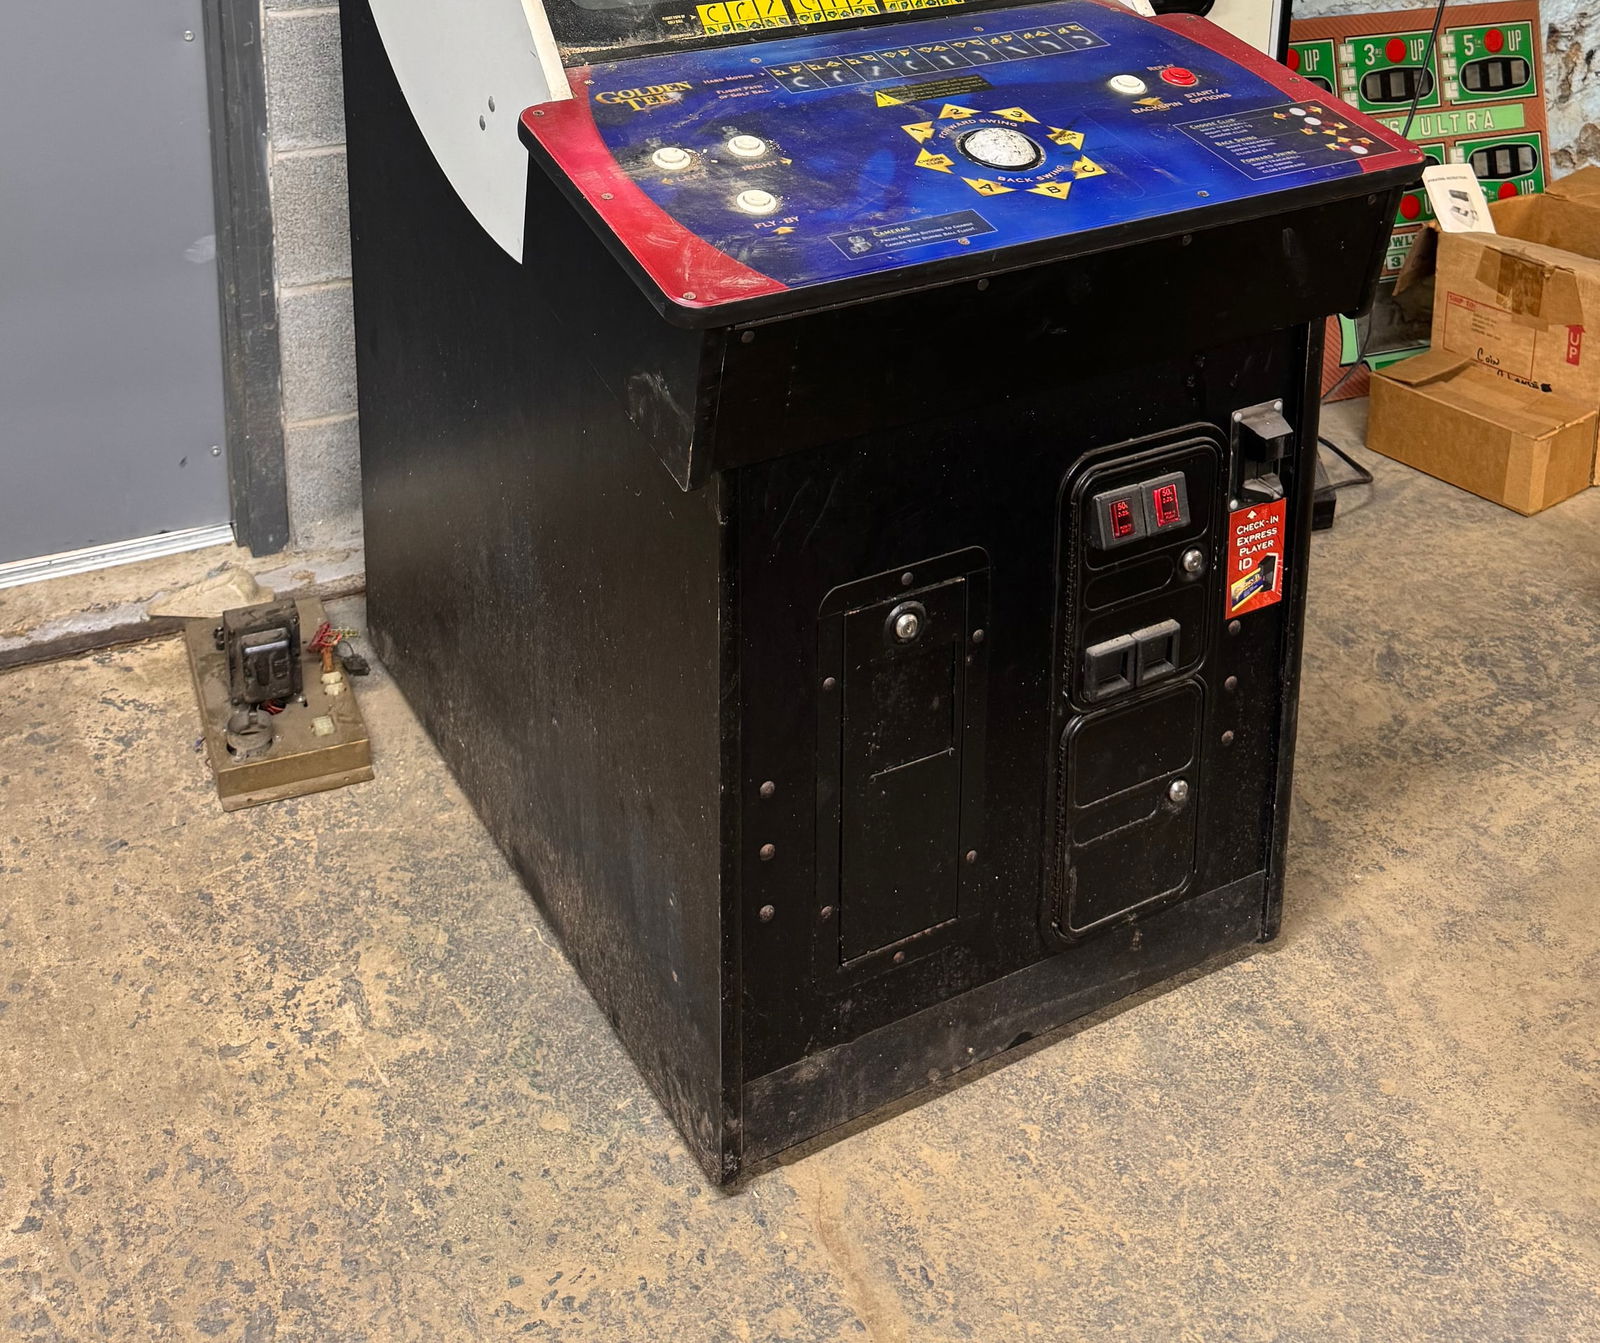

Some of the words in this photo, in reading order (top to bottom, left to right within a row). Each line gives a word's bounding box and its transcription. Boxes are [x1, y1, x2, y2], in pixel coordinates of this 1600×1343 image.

[1410, 38, 1425, 61] UP
[1507, 29, 1522, 52] UP
[1304, 49, 1321, 73] UP
[594, 80, 693, 105] GOLDEN
[1188, 93, 1233, 104] OPTIONS
[622, 92, 672, 112] TEE
[1130, 101, 1184, 114] BACKSPIN
[1010, 110, 1023, 118] 3
[1420, 110, 1495, 136] ULTRA
[938, 118, 977, 139] FORWARD
[978, 118, 1018, 128] SWING
[741, 160, 778, 172] RIGHT
[997, 175, 1034, 184] BACK
[1036, 164, 1065, 181] SWING
[1081, 163, 1095, 174] C
[979, 183, 994, 193] A
[1047, 185, 1061, 195] B
[1520, 179, 1535, 195] UP
[872, 226, 912, 237] CAMERAS
[1391, 256, 1401, 268] 3
[1568, 332, 1580, 359] UP
[1477, 347, 1500, 366] Coin
[1236, 527, 1278, 547] EXPRESS
[1239, 539, 1275, 557] PLAYER
[1238, 557, 1253, 571] ID
